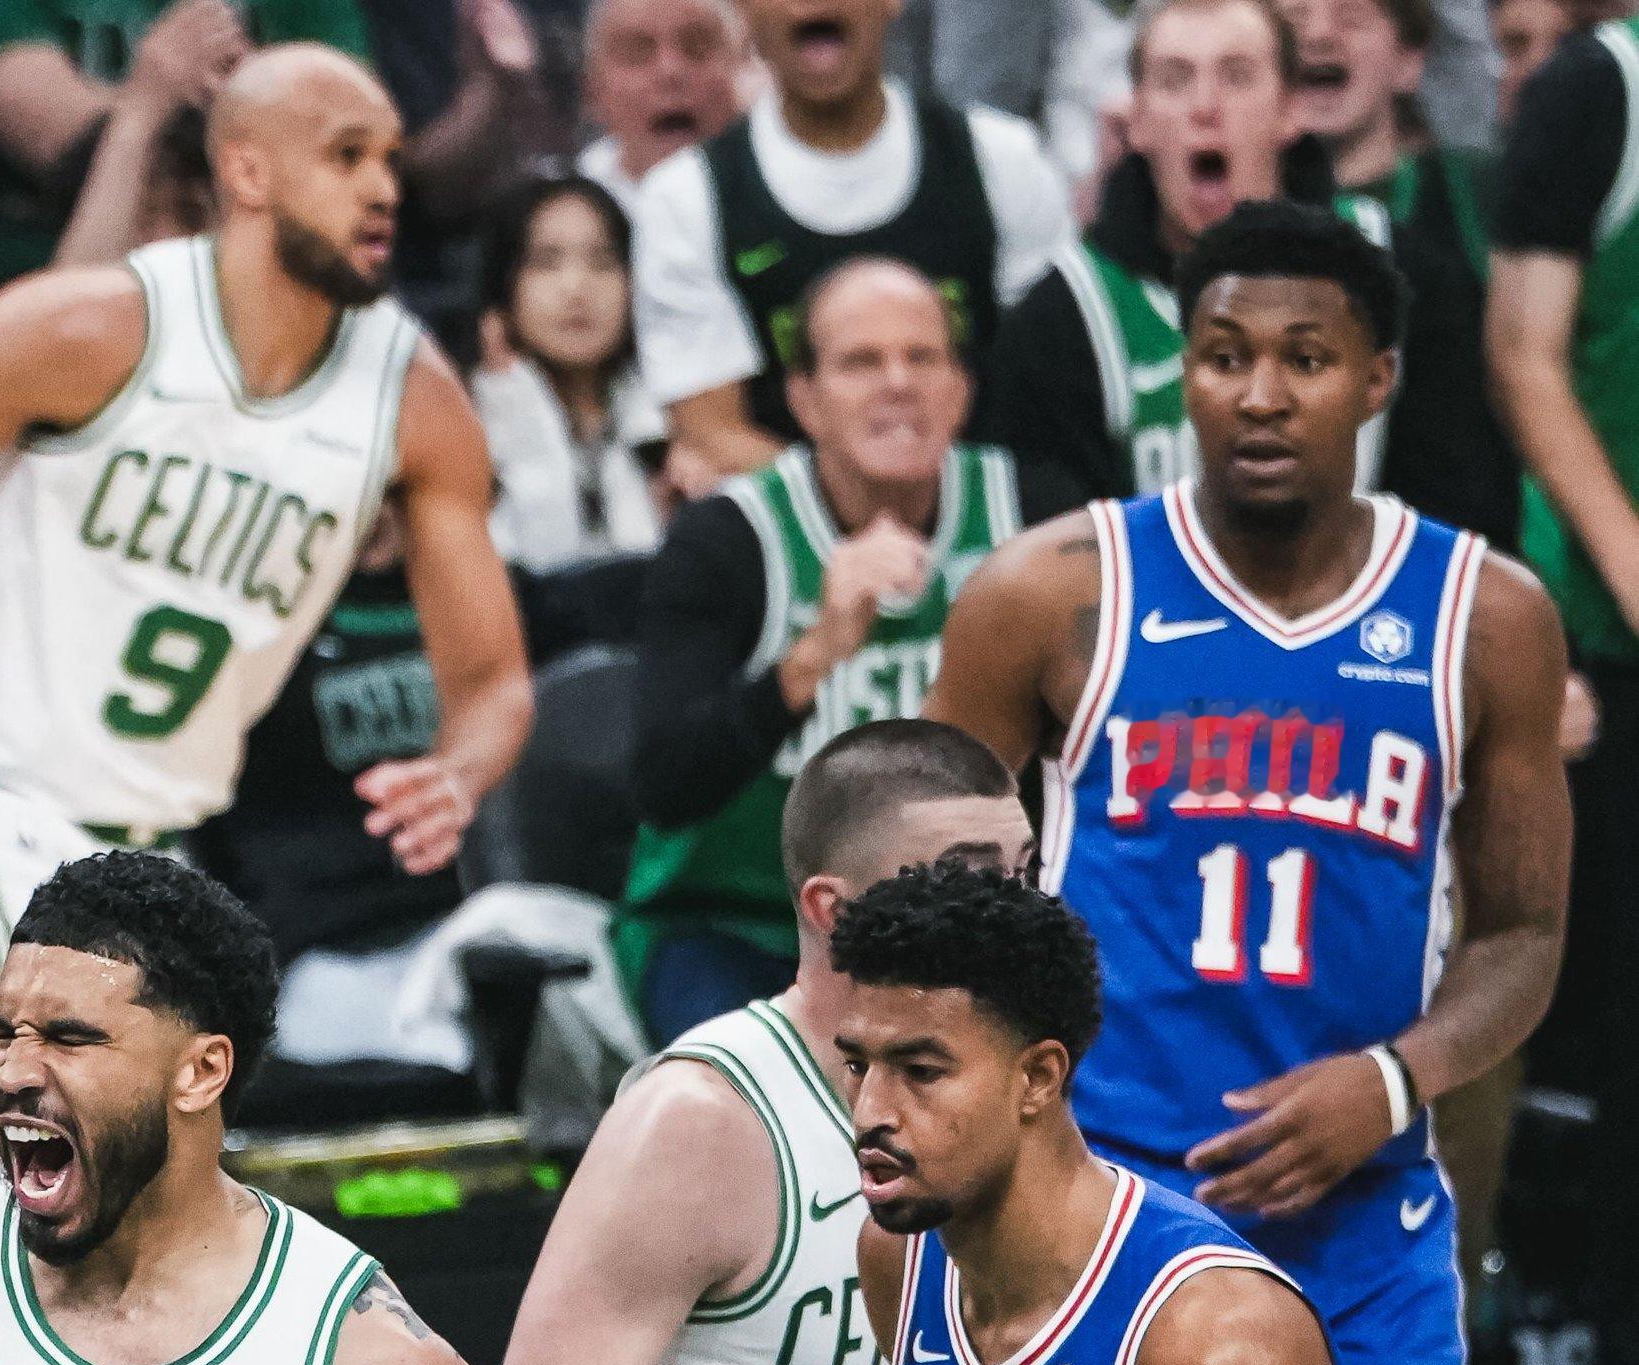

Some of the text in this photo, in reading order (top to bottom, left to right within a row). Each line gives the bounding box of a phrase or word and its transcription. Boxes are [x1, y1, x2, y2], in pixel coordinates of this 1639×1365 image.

[78, 449, 338, 619] CELTICS
[100, 602, 233, 742] 9
[1106, 712, 1429, 855] PHILA
[1192, 842, 1315, 986] 11
